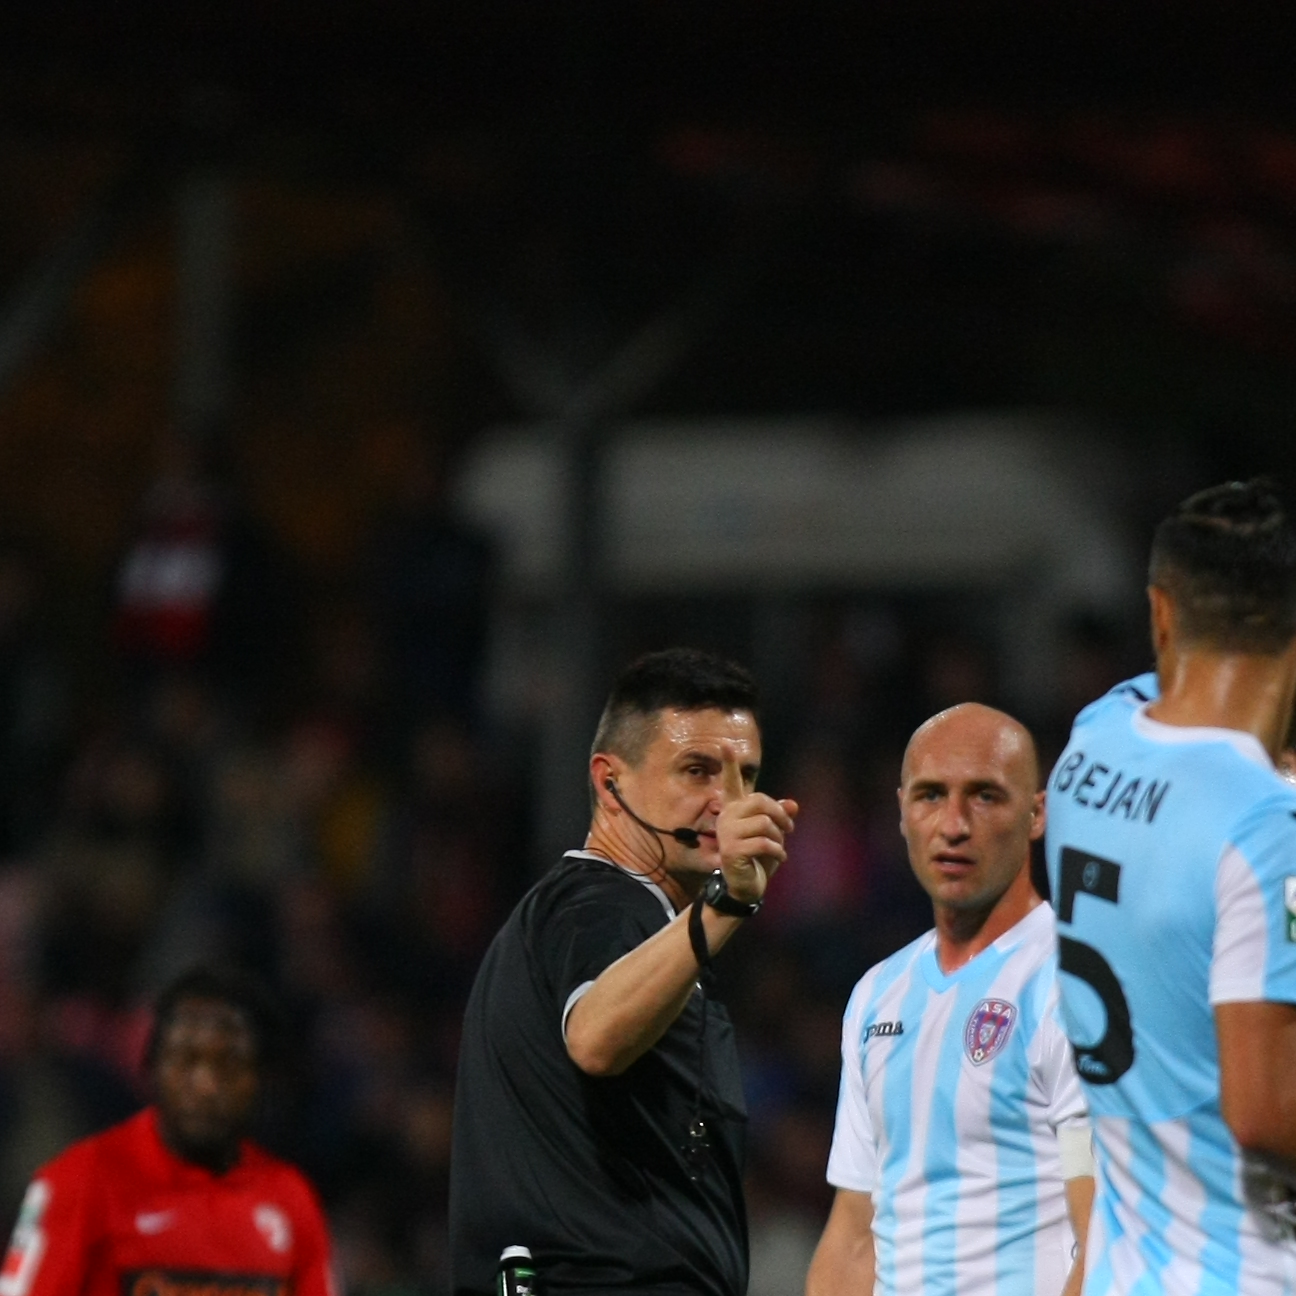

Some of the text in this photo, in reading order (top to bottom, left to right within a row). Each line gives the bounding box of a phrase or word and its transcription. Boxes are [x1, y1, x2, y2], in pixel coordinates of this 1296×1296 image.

[1056, 751, 1169, 824] BEJAN
[1057, 845, 1135, 1085] 5
[979, 1002, 1012, 1019] ASA
